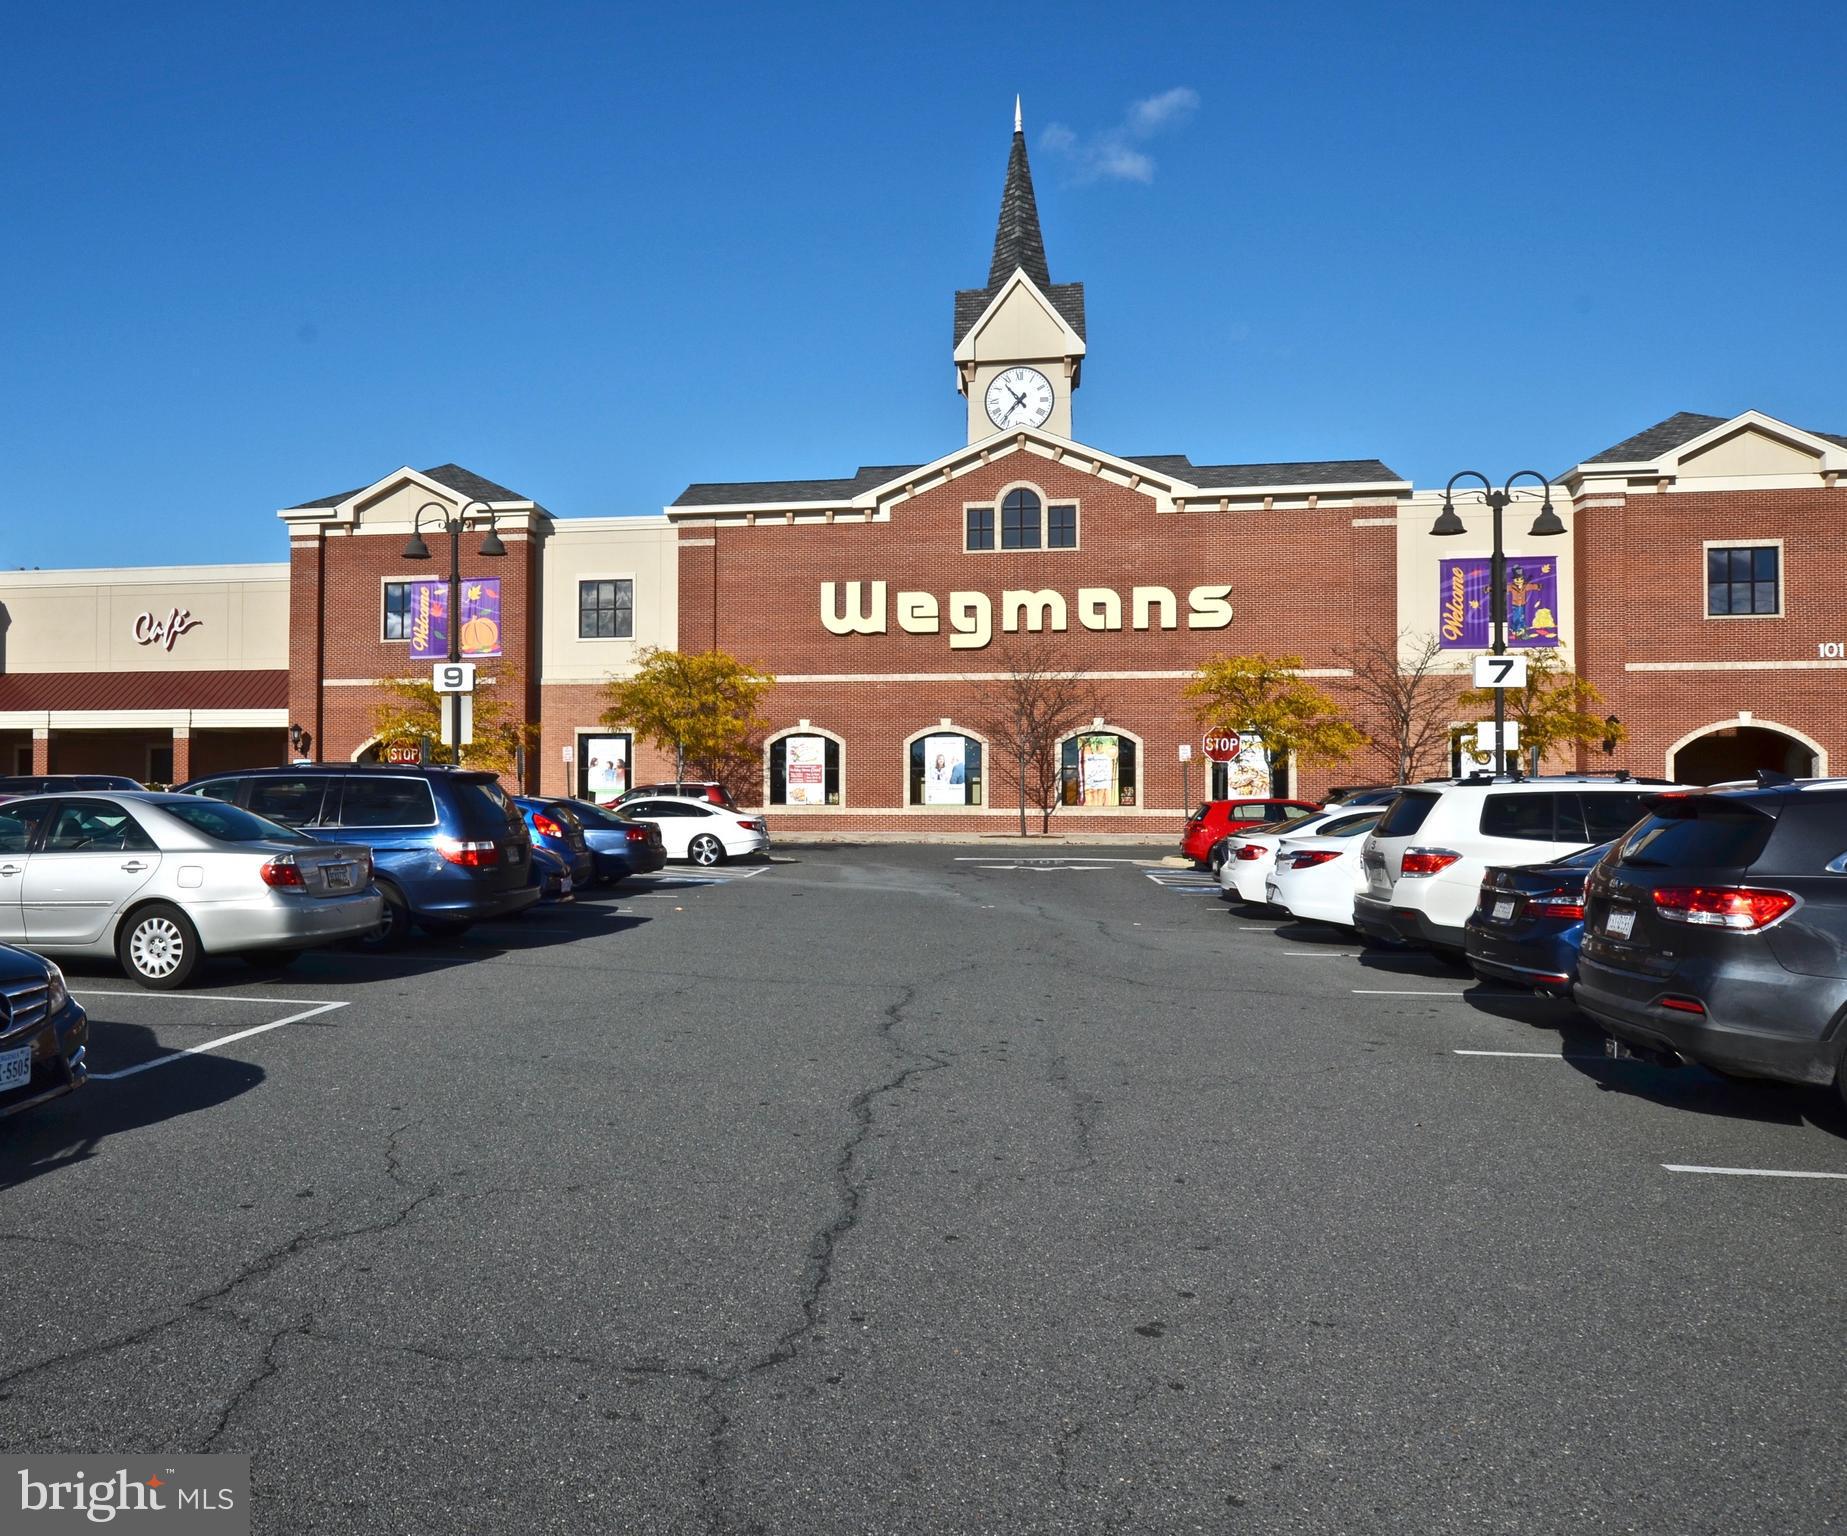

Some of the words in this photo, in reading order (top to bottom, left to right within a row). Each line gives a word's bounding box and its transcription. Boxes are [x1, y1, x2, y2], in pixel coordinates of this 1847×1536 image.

[819, 579, 1234, 649] Wegmans
[1442, 566, 1465, 642] Welcome
[412, 585, 431, 652] Welcome
[1817, 642, 1845, 658] 101
[443, 666, 464, 689] 9
[1488, 659, 1514, 684] 7
[390, 747, 419, 761] STOP
[1205, 737, 1239, 752] STOP
